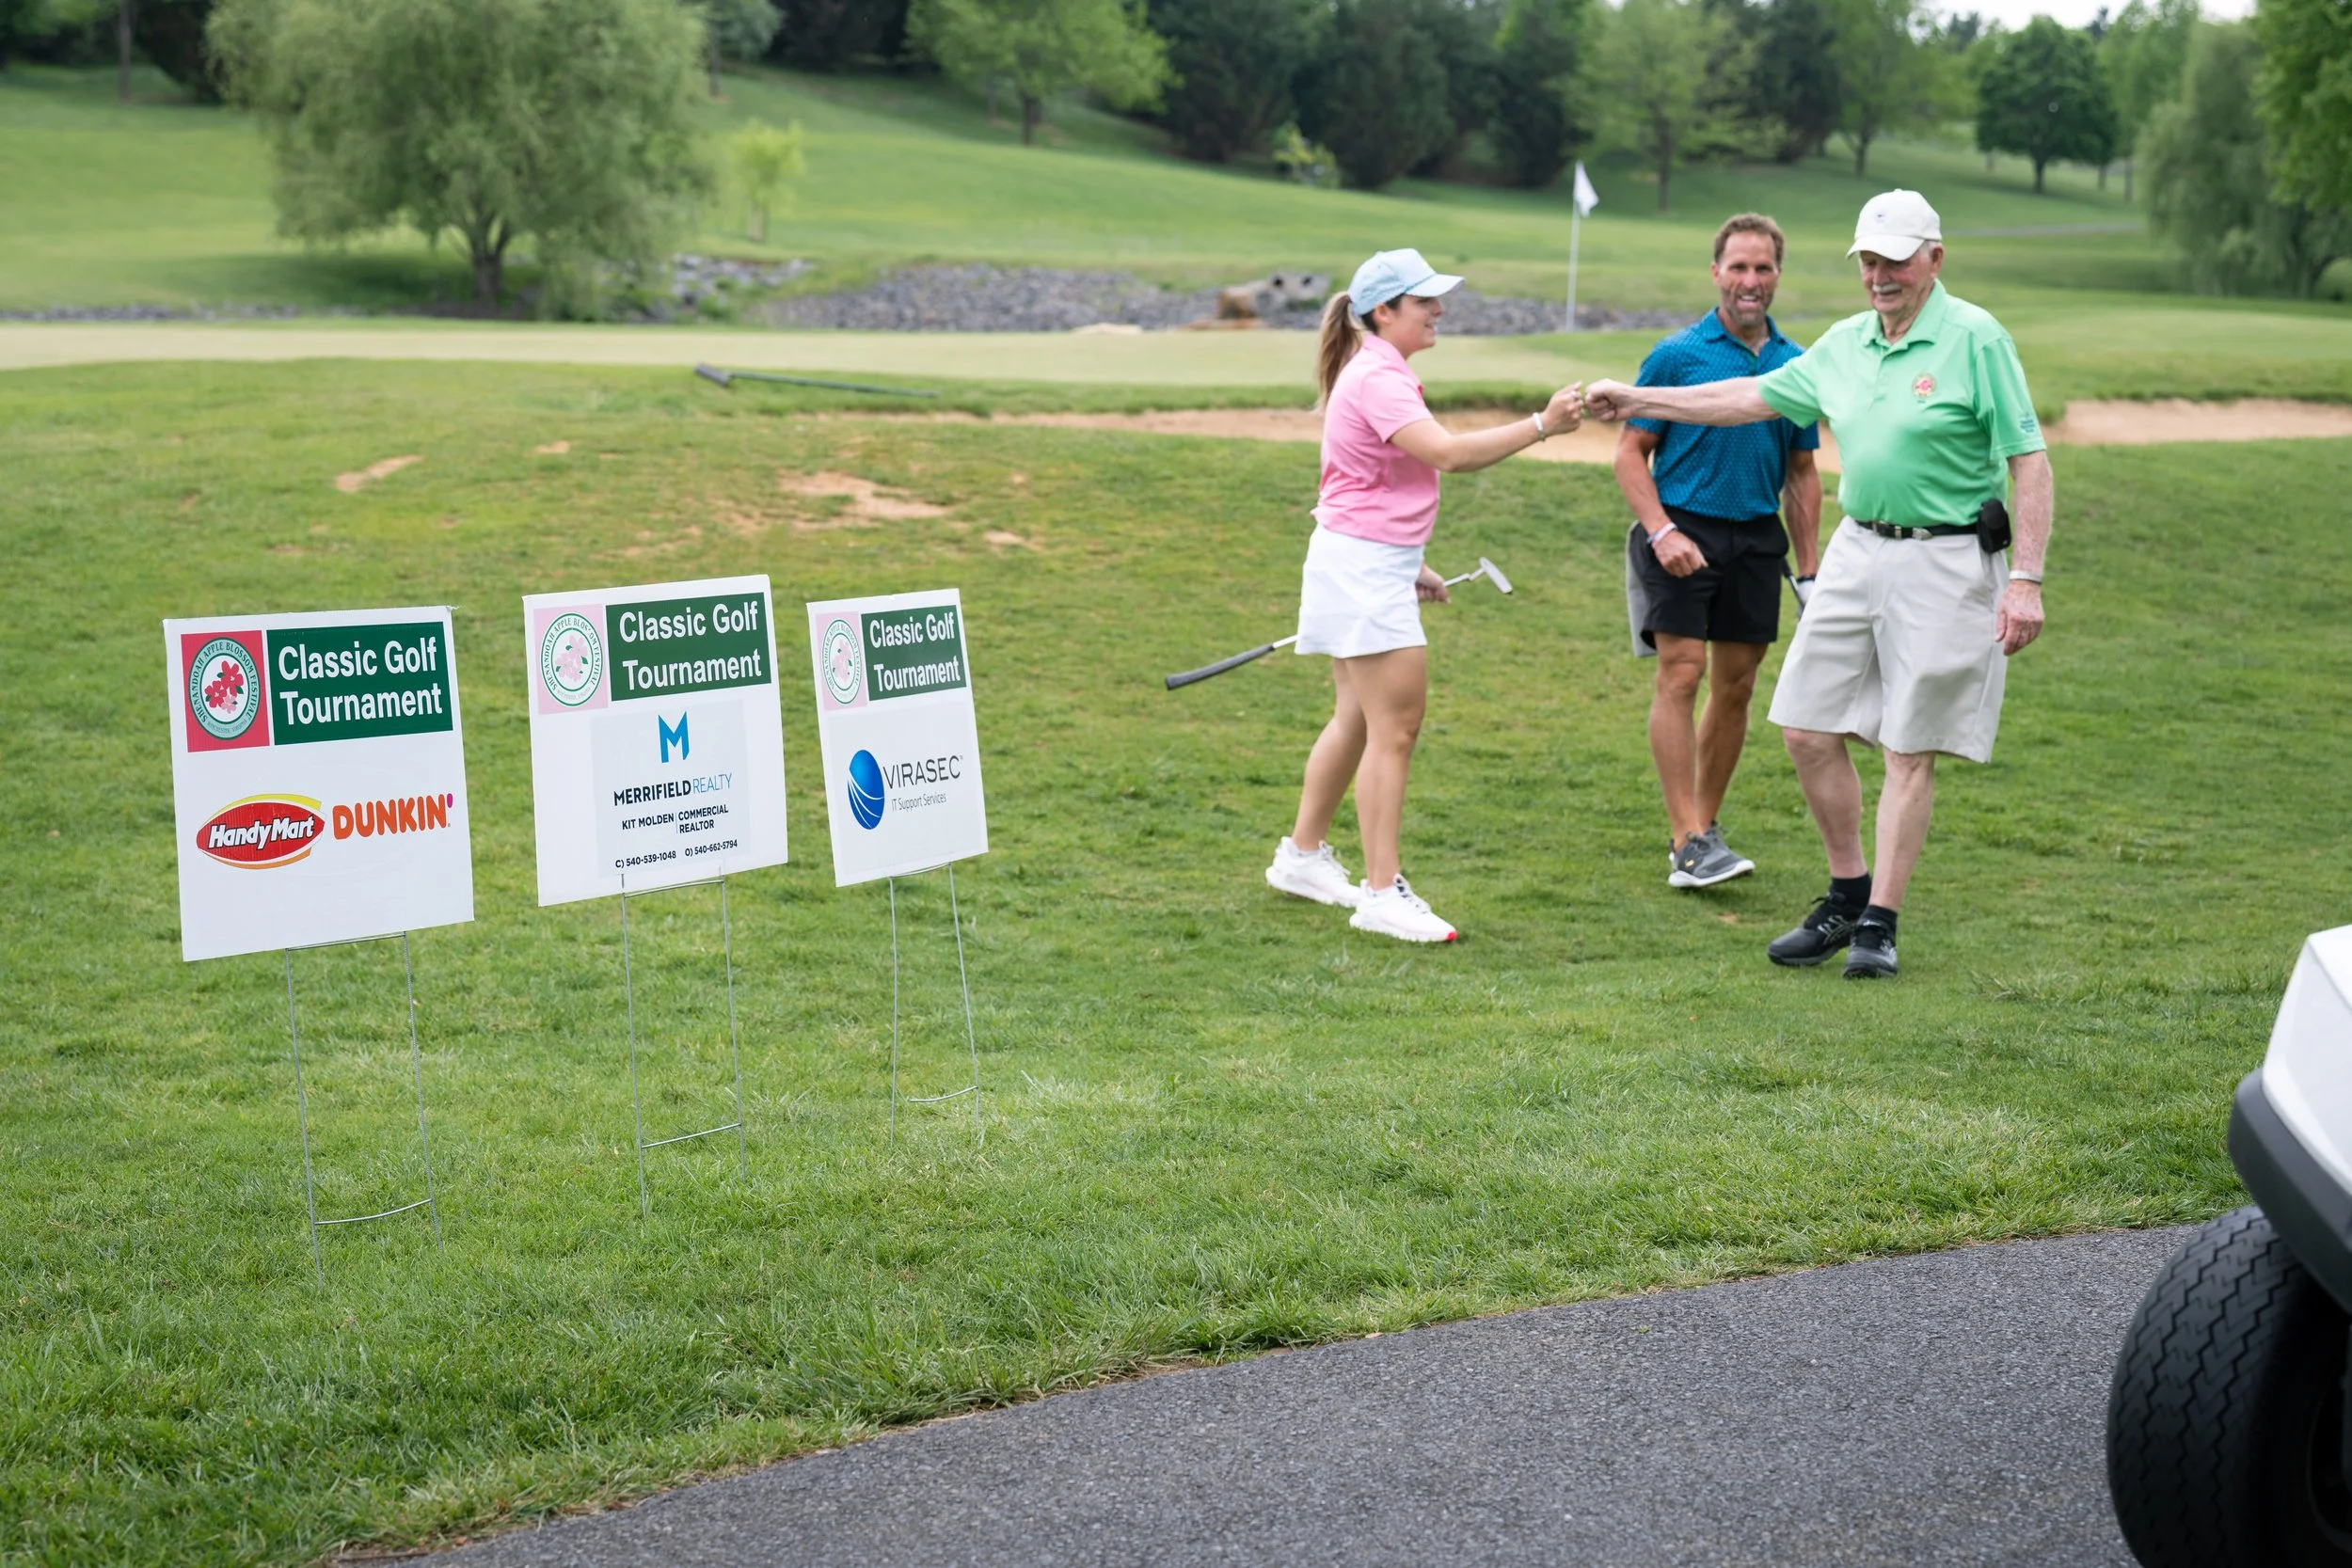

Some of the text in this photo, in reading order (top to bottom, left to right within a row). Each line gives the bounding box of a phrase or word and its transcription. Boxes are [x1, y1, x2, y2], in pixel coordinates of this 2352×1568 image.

[619, 600, 758, 643] Classic Golf
[869, 611, 955, 649] Classic Golf
[278, 636, 437, 681] Classic Golf
[622, 648, 763, 690] Tournament
[873, 655, 961, 692] Tournament
[191, 641, 259, 723] SHENANDOAH APPLE BLOSSOM FESTIVAL
[279, 683, 443, 725] Tournament
[613, 772, 732, 806] MERRIFIELD REALTY
[882, 754, 961, 789] VIRASEC
[332, 793, 453, 840] DUNKIN'
[677, 804, 729, 821] COMMERCIAL
[891, 792, 947, 812] IT Support Services
[622, 813, 675, 831] KIT MOLDEN
[679, 819, 715, 834] REALTOR
[614, 850, 677, 869] C) 540-539-1048
[694, 839, 739, 855] 540-662-5794
